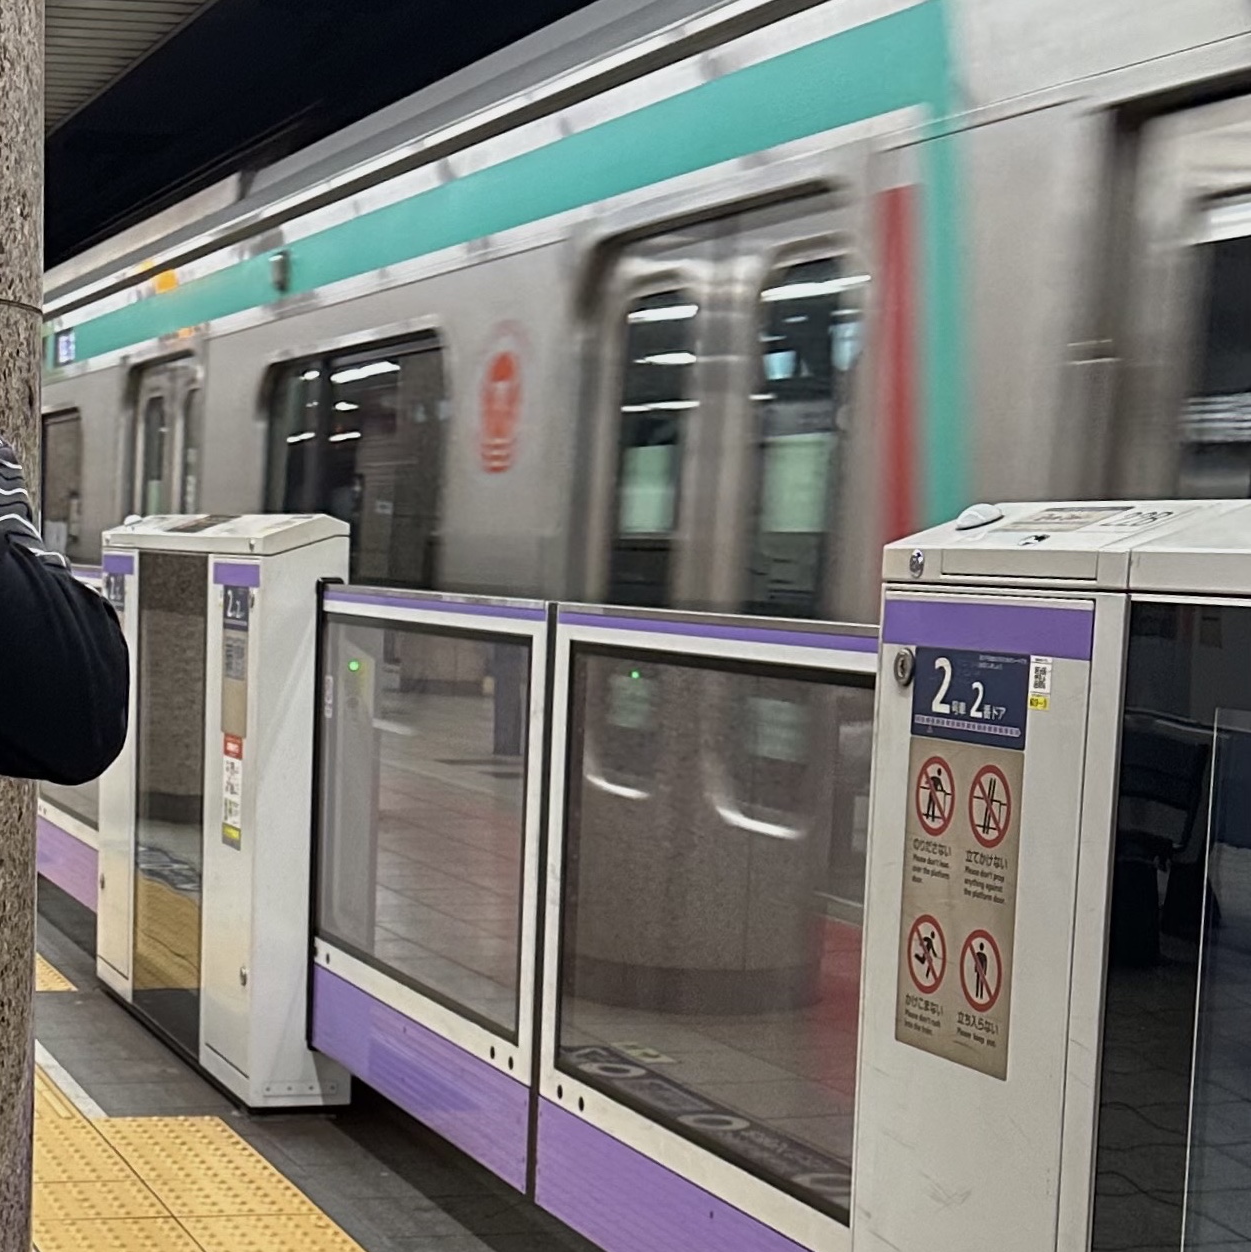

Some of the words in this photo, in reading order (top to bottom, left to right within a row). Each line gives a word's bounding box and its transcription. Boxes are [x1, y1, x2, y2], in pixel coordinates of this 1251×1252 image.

[965, 850, 1008, 870] 立てかけない
[957, 1011, 999, 1035] 立ち入らない
